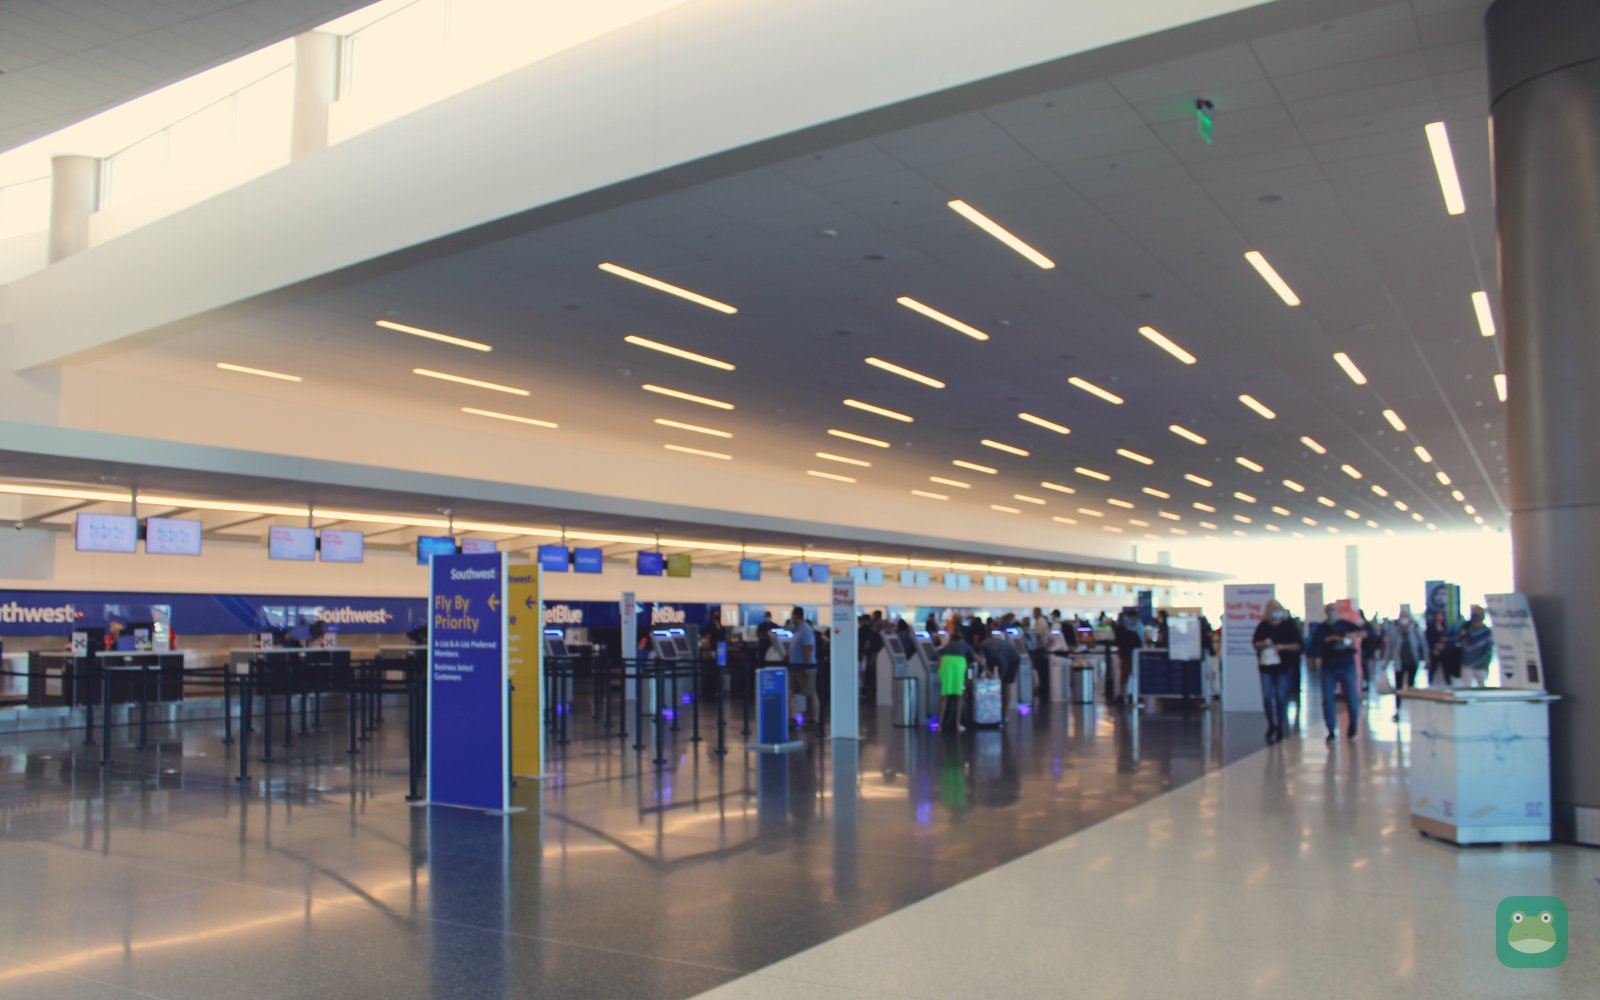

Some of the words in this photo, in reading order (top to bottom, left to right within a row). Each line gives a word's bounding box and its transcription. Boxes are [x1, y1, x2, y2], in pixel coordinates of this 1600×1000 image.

[450, 568, 496, 580] Southwest
[0, 601, 75, 624] thwest
[434, 594, 452, 615] Fly
[454, 594, 470, 615] By
[651, 603, 686, 625] jetBlue
[314, 606, 386, 624] Southwest
[434, 614, 480, 634] Priority
[471, 640, 497, 649] Preferred
[457, 664, 474, 672] Select
